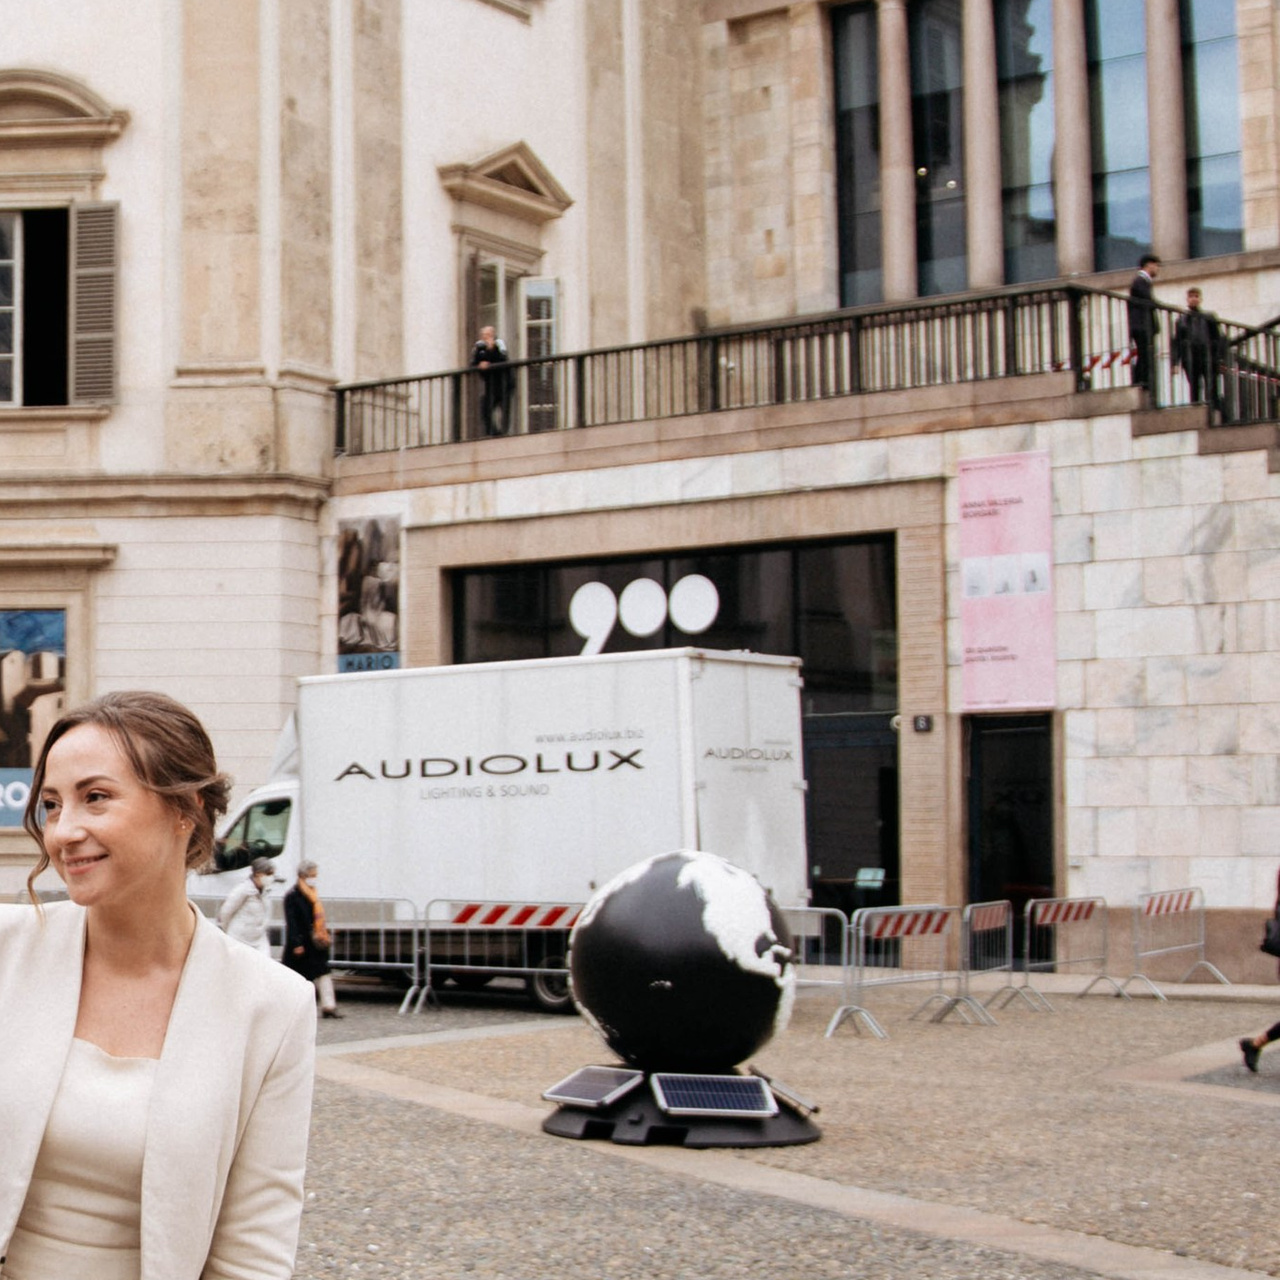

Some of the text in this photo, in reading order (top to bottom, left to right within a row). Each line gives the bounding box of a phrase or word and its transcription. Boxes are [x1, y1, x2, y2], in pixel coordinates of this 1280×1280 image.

[346, 655, 393, 670] MARIO
[704, 747, 793, 761] AUDIOLUX
[335, 749, 644, 781] AUDIOLUX
[420, 783, 550, 800] LIGHTING & SOUND
